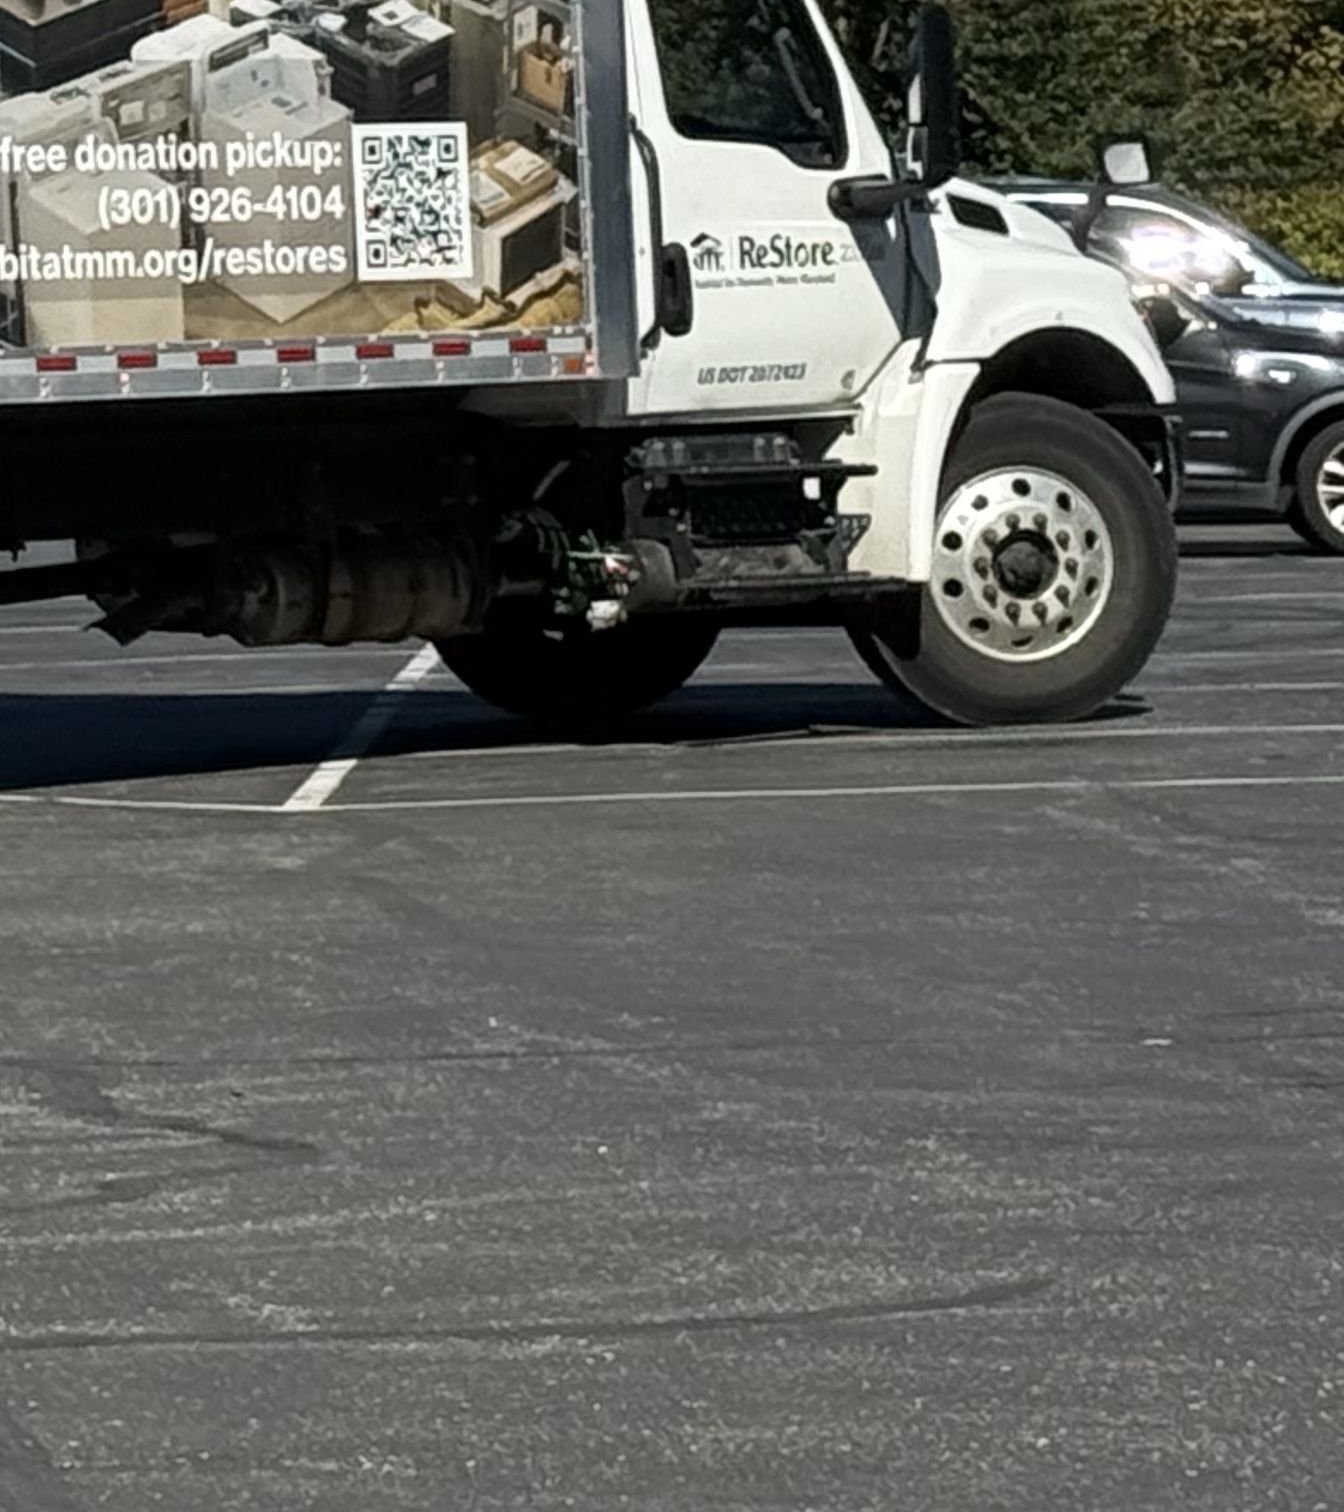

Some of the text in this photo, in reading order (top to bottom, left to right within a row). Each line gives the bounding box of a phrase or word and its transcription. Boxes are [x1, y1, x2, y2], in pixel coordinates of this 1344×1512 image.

[75, 132, 218, 172] donation
[226, 129, 343, 178] pickup:
[97, 184, 344, 230] (301) 926-4104
[738, 234, 836, 270] ReStore
